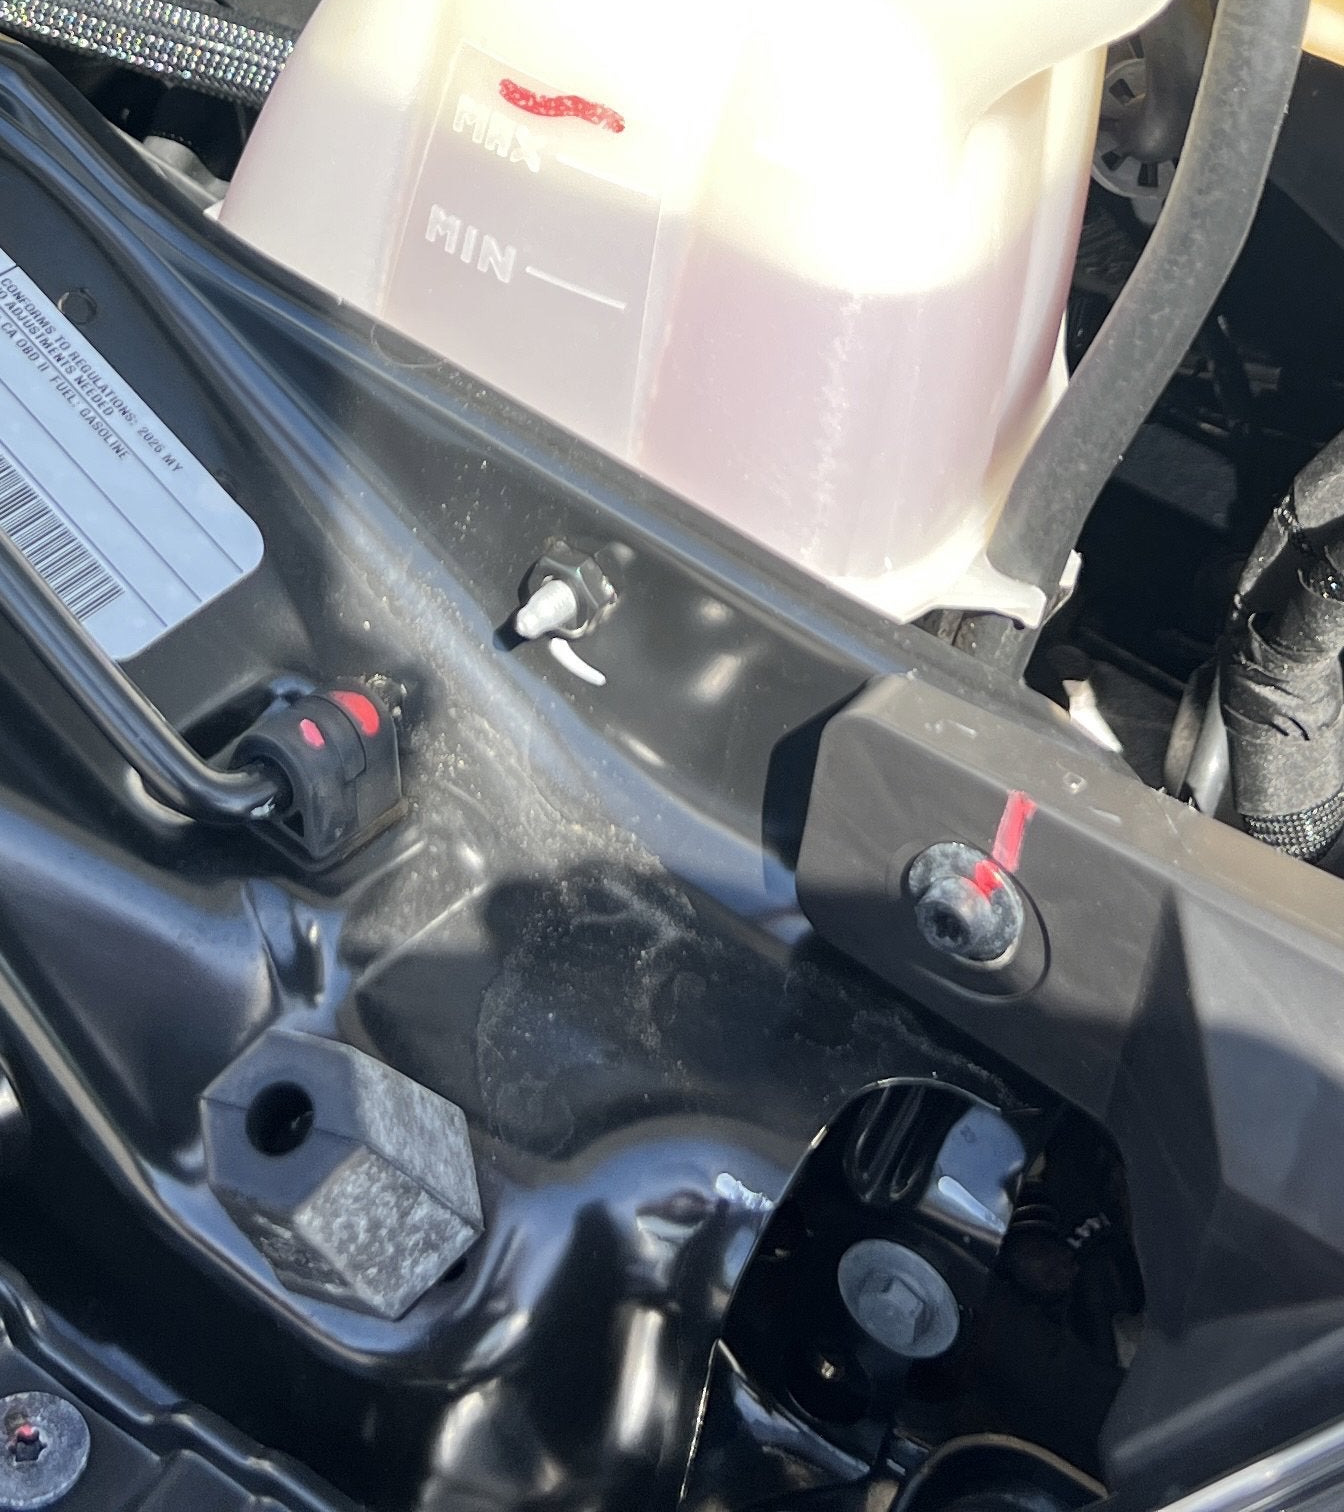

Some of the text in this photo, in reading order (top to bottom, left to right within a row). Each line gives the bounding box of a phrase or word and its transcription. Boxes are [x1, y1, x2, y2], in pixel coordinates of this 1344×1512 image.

[452, 94, 548, 173] MAX
[424, 203, 517, 284] MIN
[1, 322, 16, 339] CA
[16, 339, 41, 362] OBD
[1, 277, 57, 335] CONFORMS
[55, 335, 71, 351] TO
[67, 351, 139, 427] REGULATIONS:
[162, 454, 184, 473] MY
[7, 301, 76, 375] ADJUSTMENTS
[74, 375, 115, 417] NEEDED
[50, 375, 131, 460] FUEL: GASOLINE
